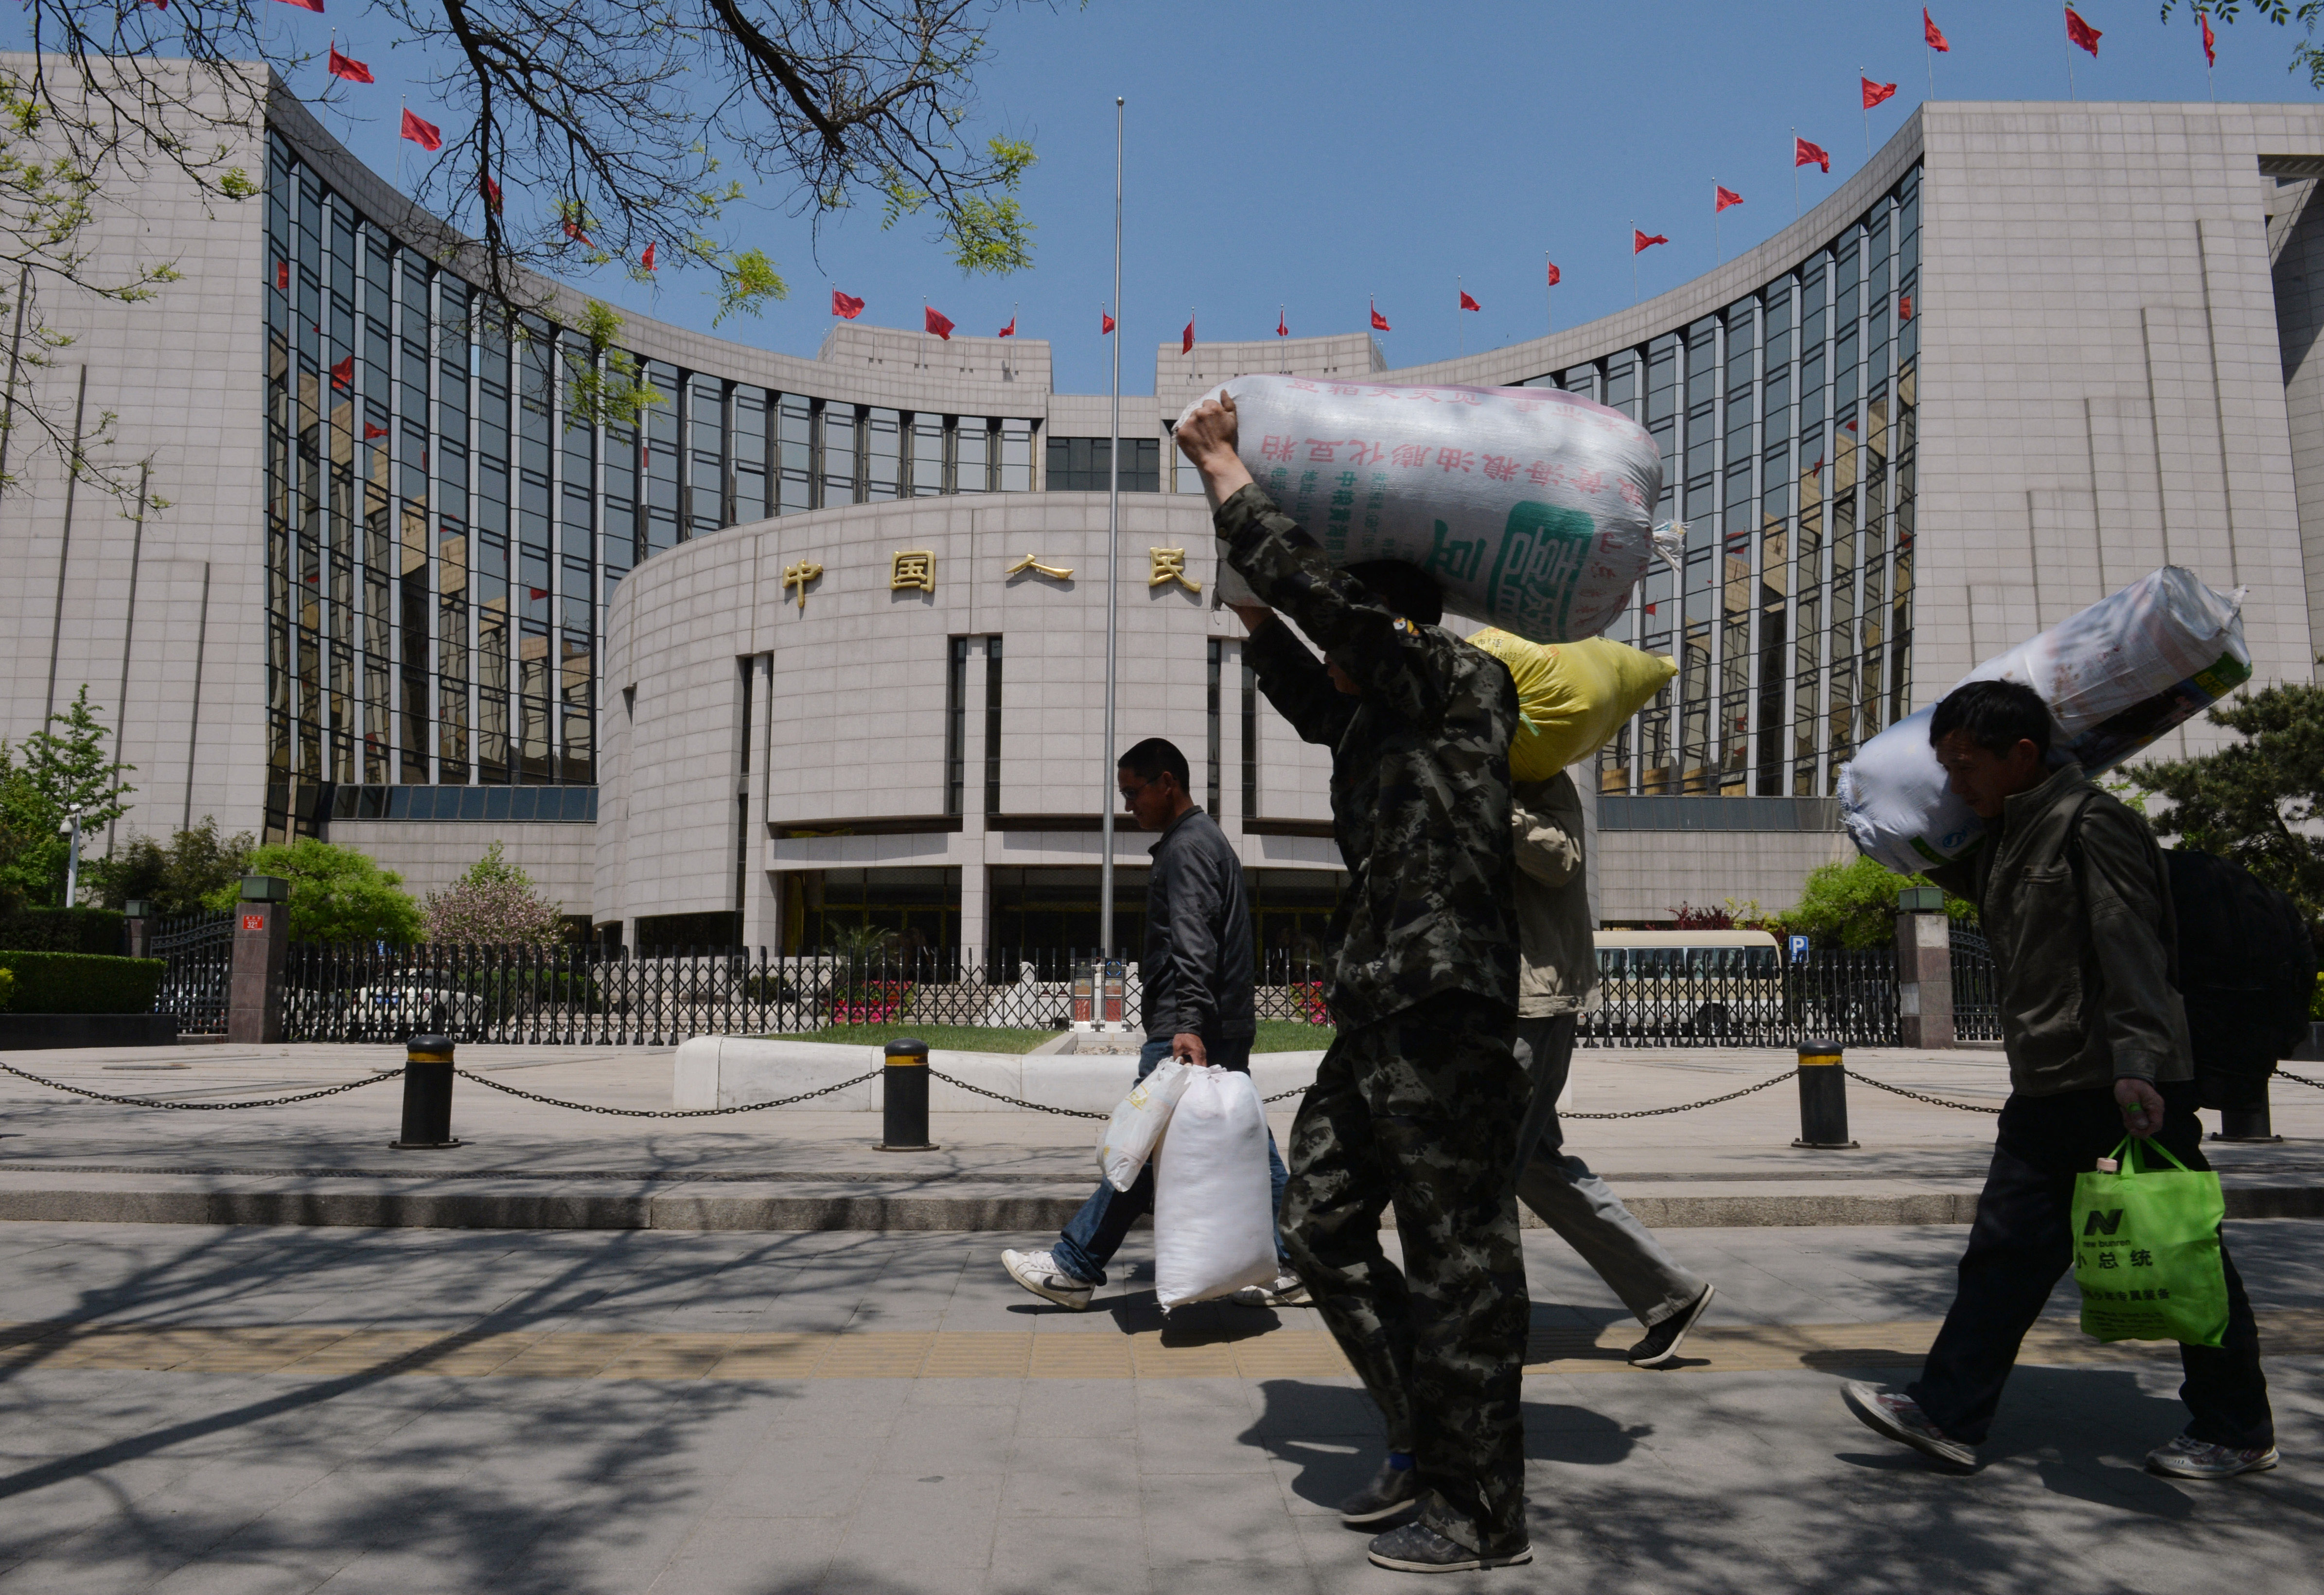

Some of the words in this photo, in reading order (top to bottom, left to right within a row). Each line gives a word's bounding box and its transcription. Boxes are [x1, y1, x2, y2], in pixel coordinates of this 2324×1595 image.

[782, 547, 1201, 609] 中国人民
[1793, 937, 1805, 954] P
